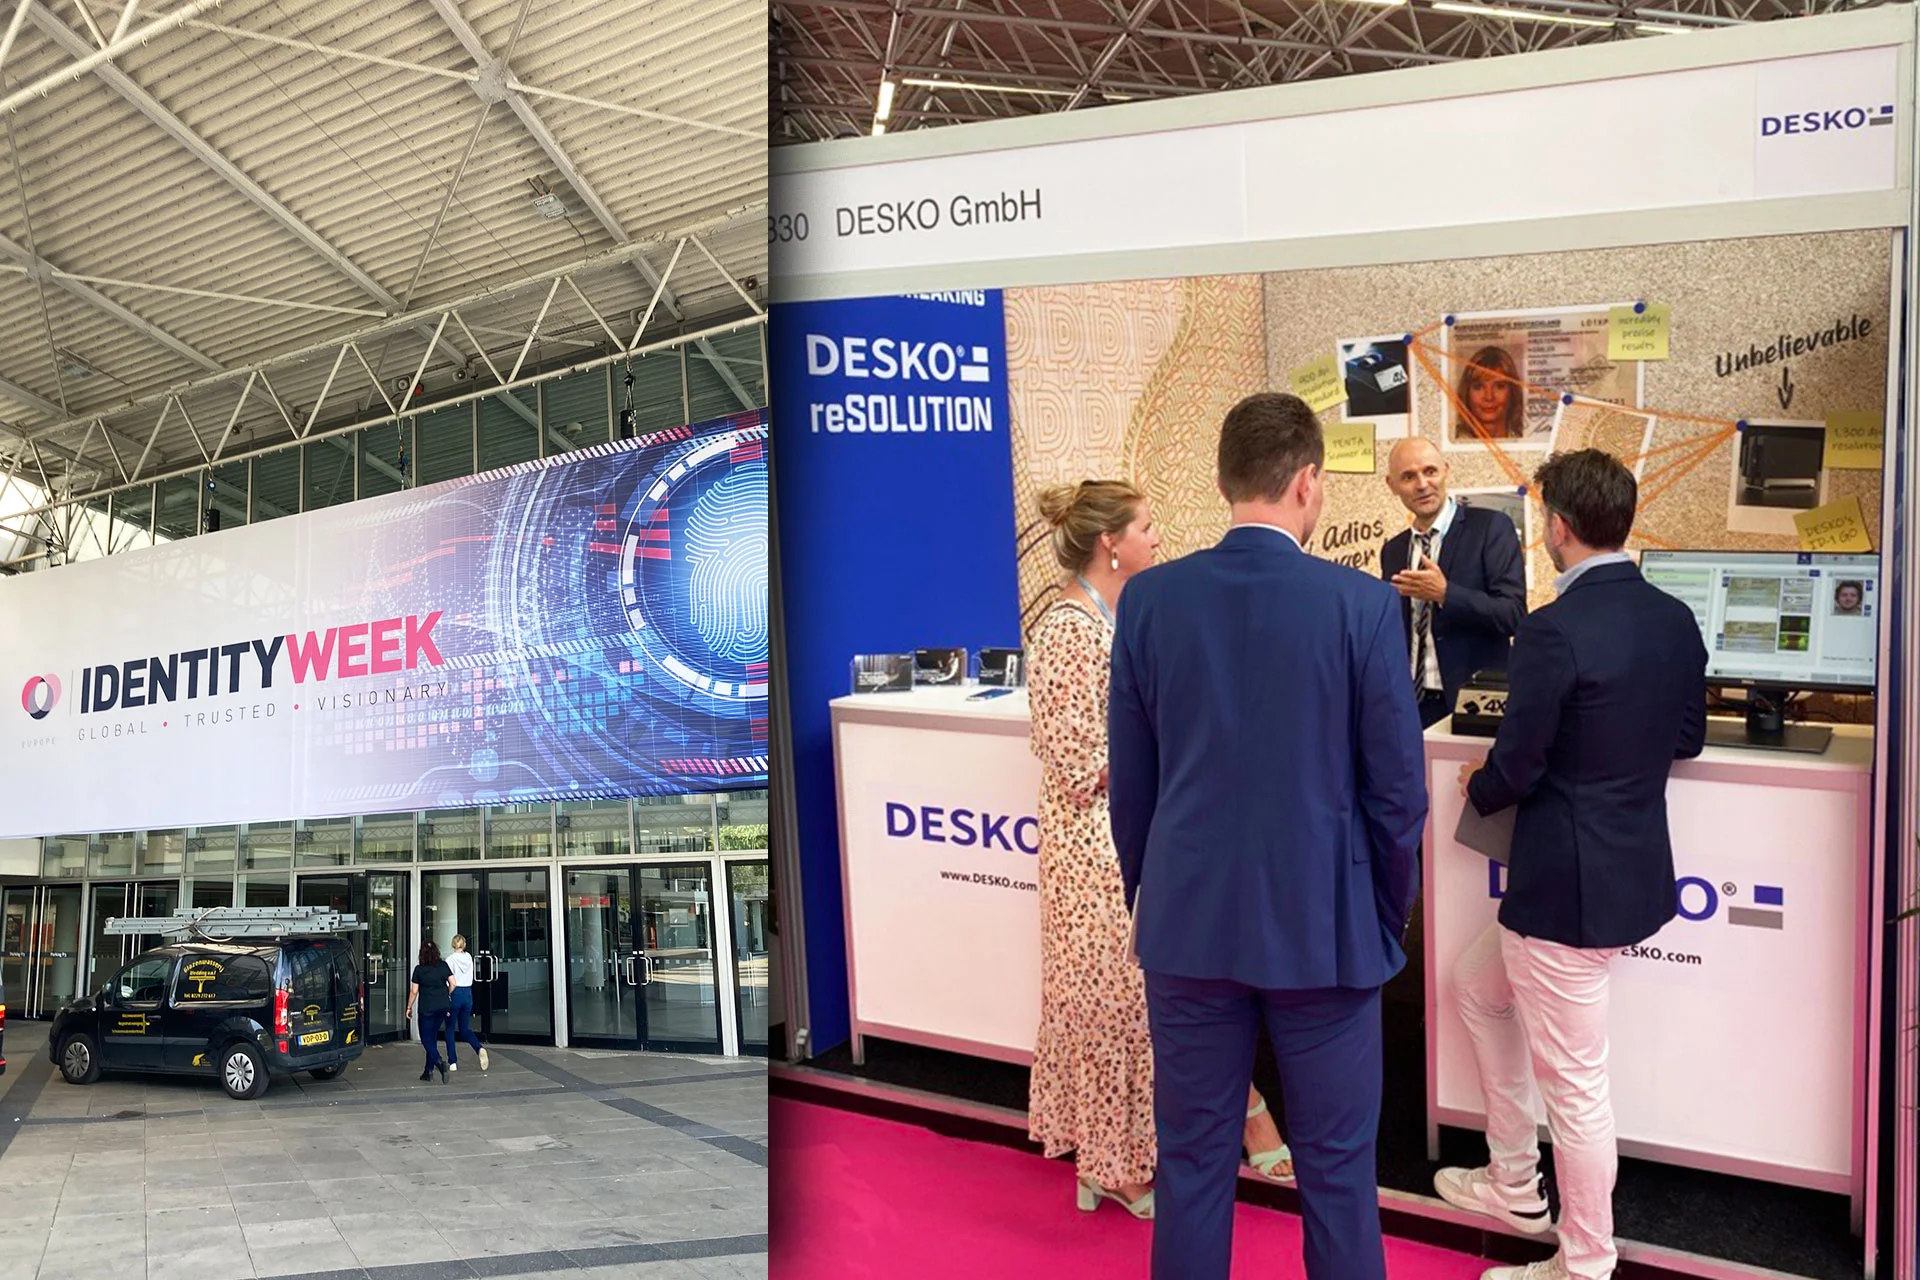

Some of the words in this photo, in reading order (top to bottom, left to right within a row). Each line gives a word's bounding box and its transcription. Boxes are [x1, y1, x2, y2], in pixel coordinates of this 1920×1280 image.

[836, 199, 940, 237] DESKO
[950, 188, 1042, 227] GmbH
[1715, 314, 1872, 378] Unbelievable
[810, 394, 993, 433] reSOLUTION
[1322, 520, 1384, 551] Adios
[78, 721, 148, 742] GLOBAL
[184, 703, 277, 728] TRUSTED
[317, 681, 448, 712] VISIONARY
[940, 869, 1038, 893] www.DESKO.com
